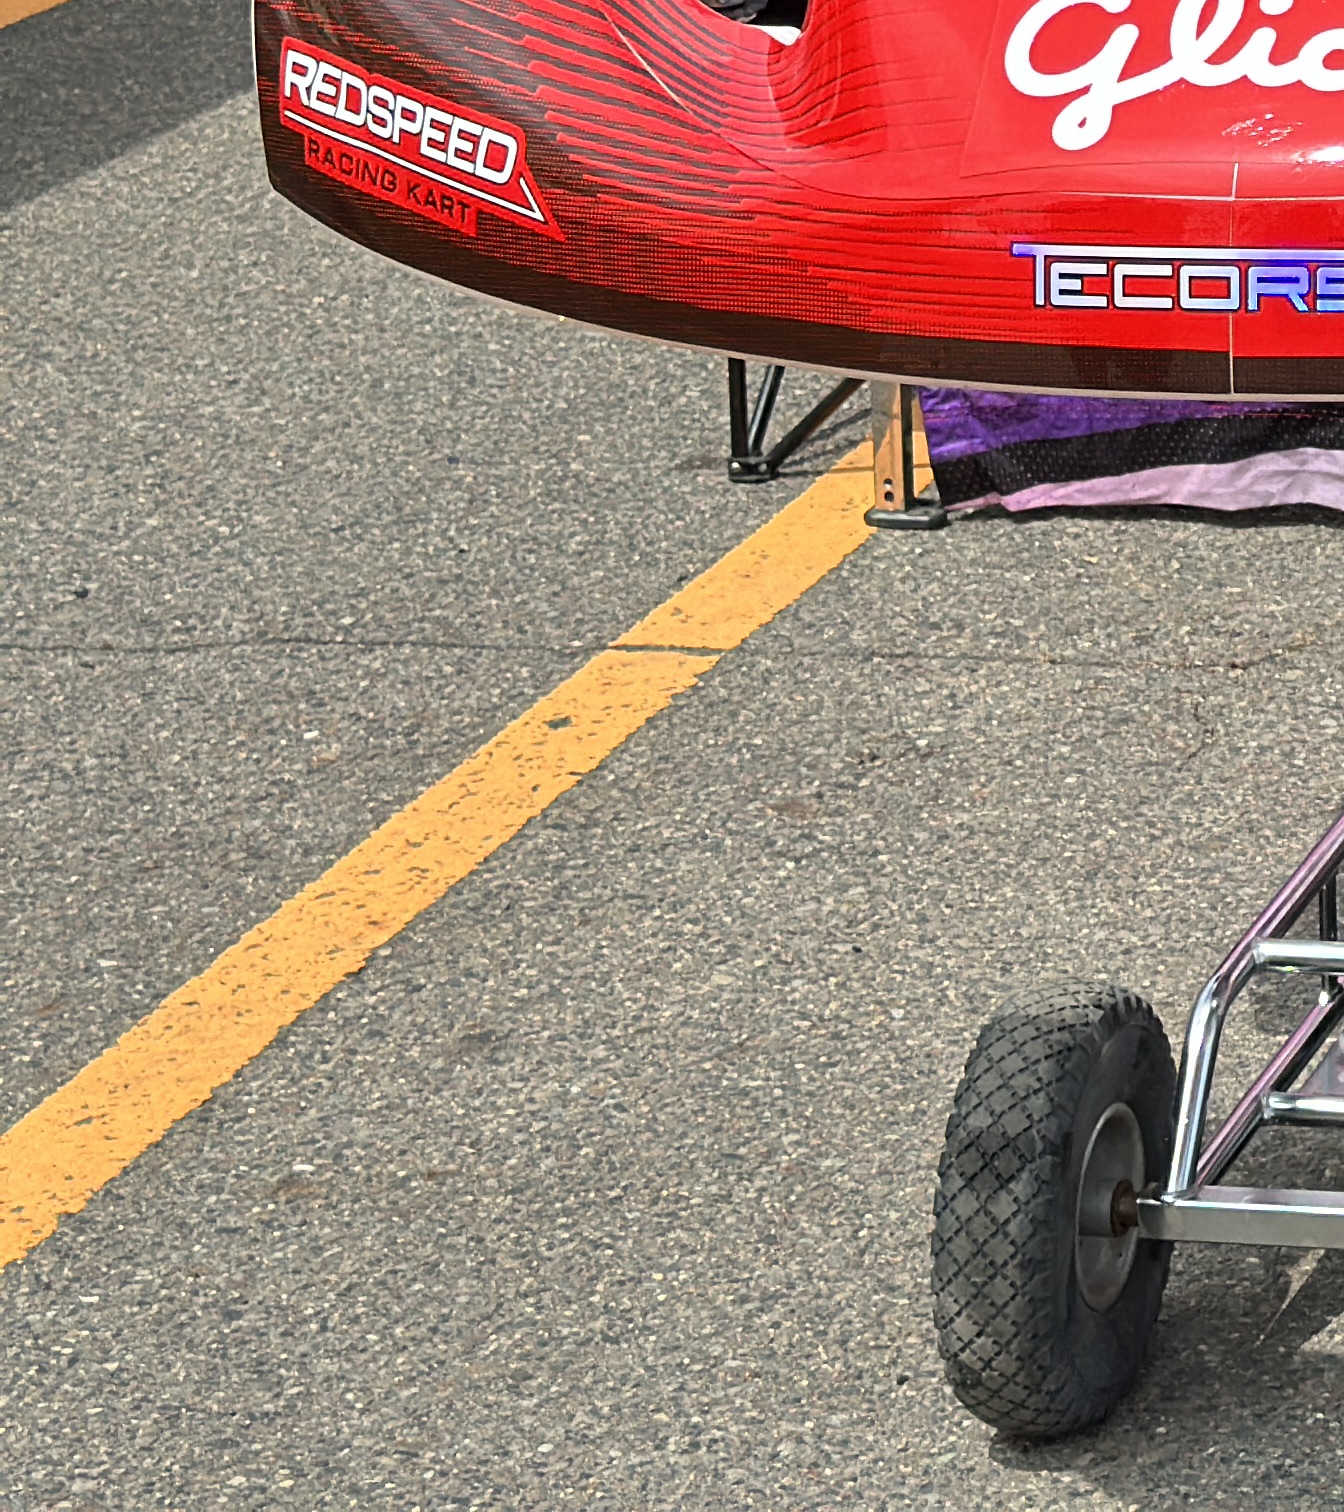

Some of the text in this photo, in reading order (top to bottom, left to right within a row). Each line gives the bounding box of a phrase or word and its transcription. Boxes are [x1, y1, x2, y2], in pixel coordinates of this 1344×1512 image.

[283, 49, 518, 186] REDSPEED
[306, 136, 472, 221] RACING KART
